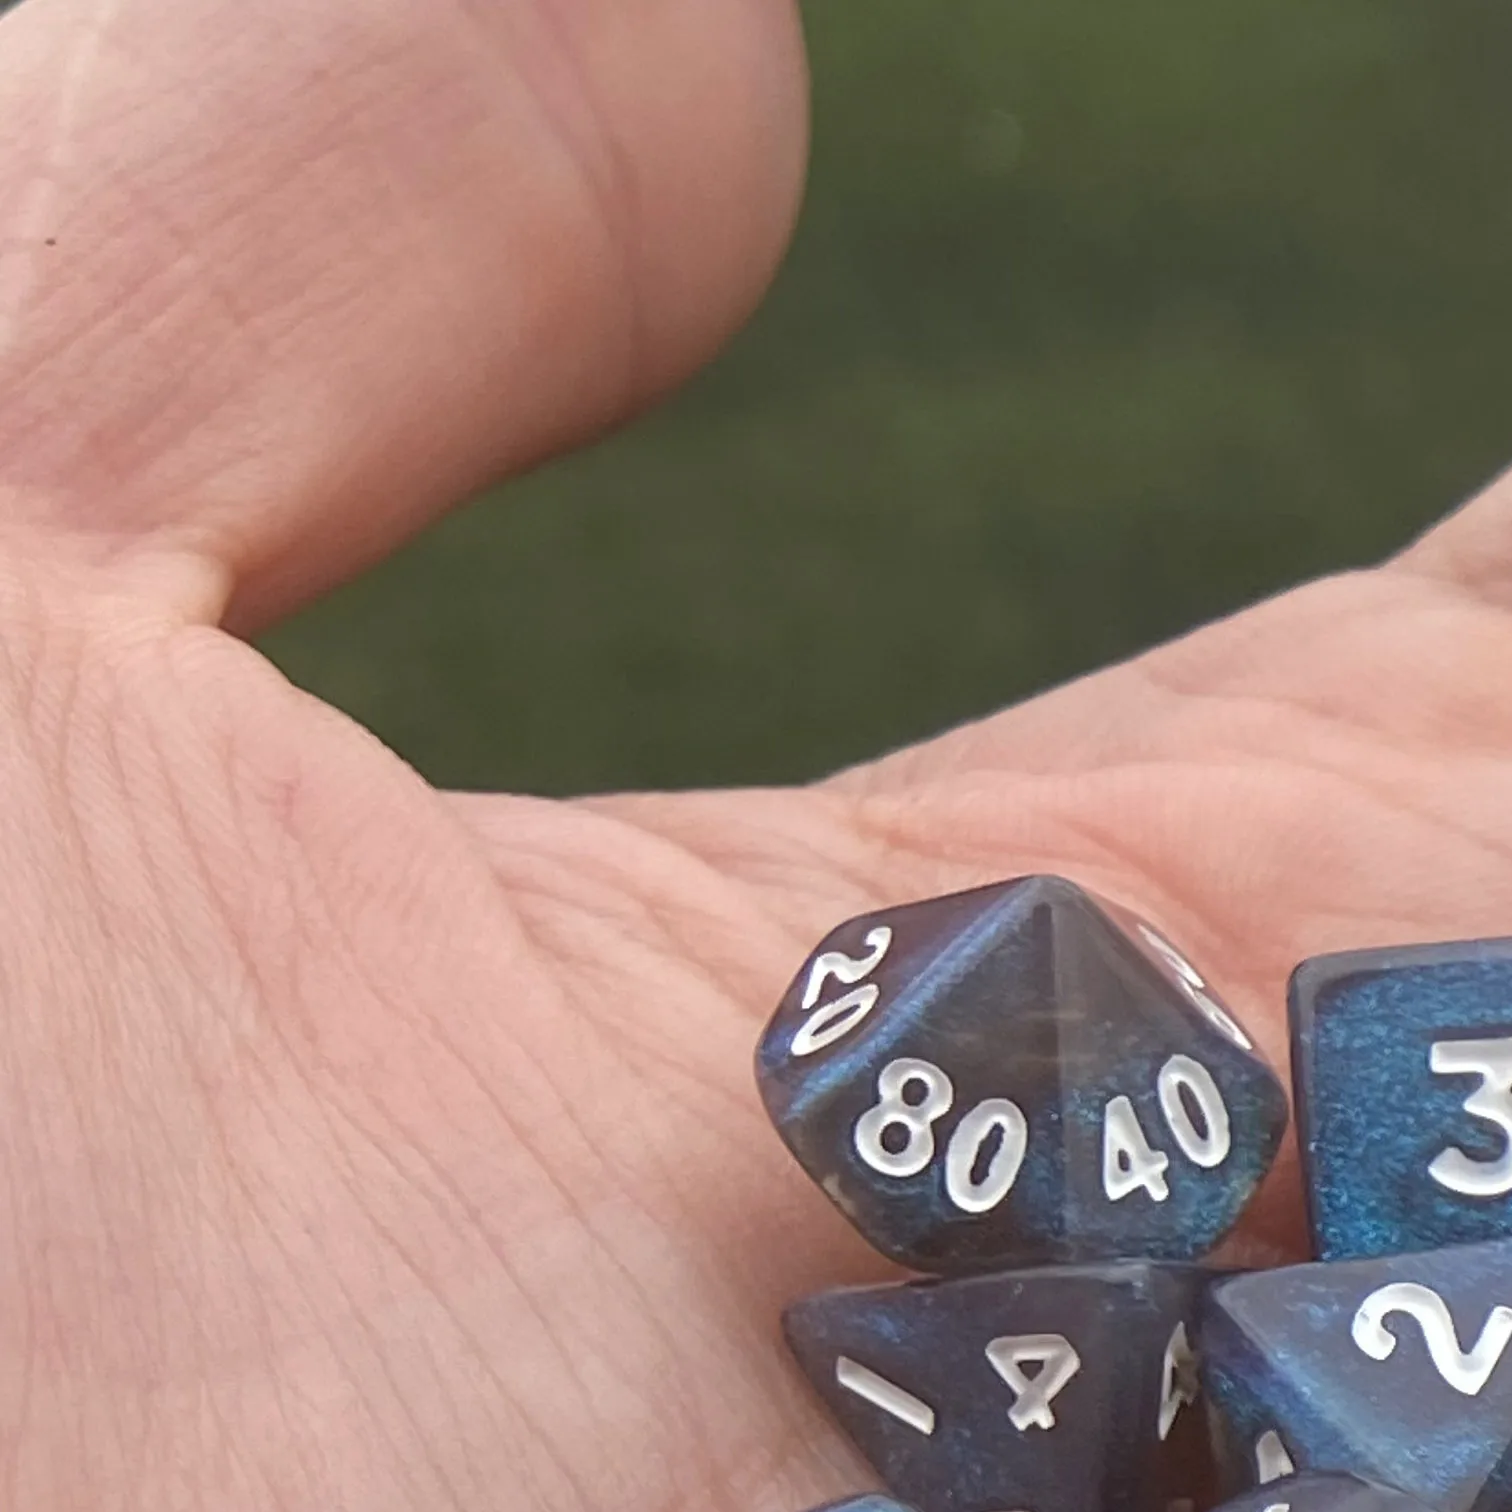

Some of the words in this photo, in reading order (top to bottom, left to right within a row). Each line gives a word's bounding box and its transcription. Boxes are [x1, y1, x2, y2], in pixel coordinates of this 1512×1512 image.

[791, 926, 892, 1057] 20
[854, 1057, 1028, 1213] 80
[1104, 1053, 1231, 1202] 40
[985, 1333, 1081, 1431] 4
